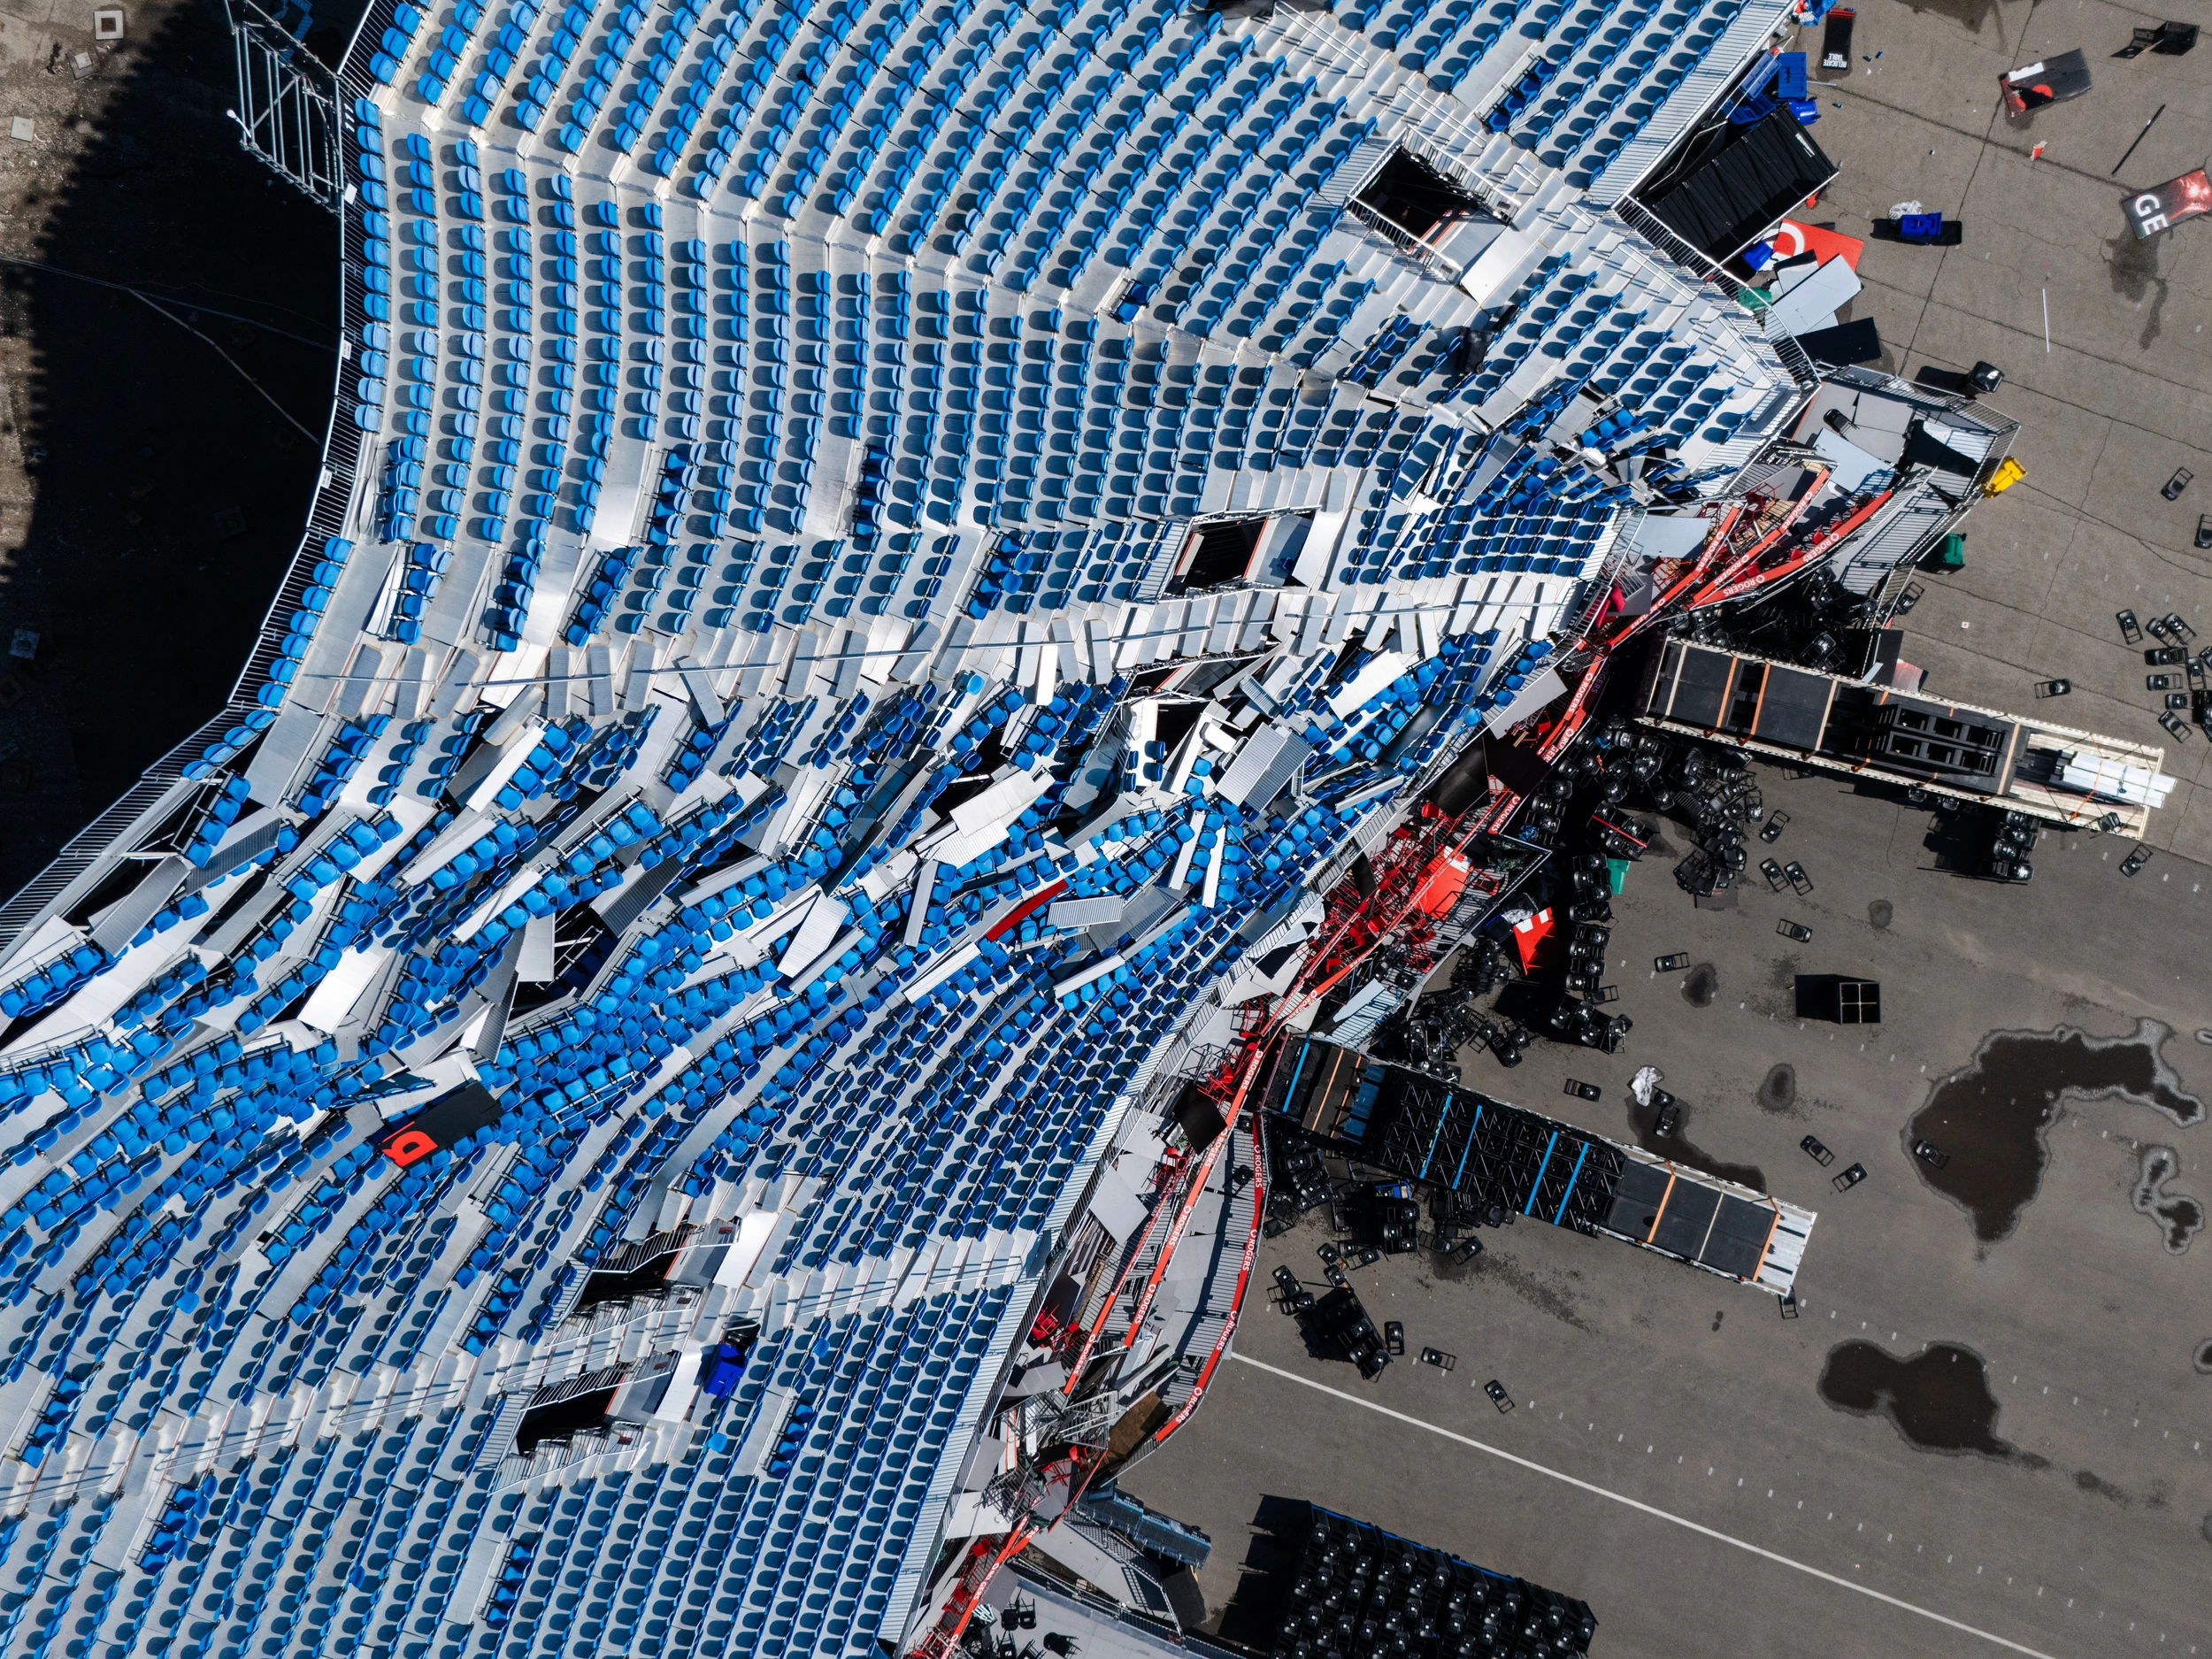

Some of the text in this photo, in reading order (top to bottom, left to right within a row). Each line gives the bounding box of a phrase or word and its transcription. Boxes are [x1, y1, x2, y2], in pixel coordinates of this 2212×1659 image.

[2135, 194, 2169, 235] GE
[1781, 500, 1810, 531] ROGERS
[1695, 541, 1721, 572] ROGERS
[1803, 541, 1834, 563] ROGERS
[1714, 561, 1745, 587] ROGERS
[1723, 577, 1756, 596] ROGERS
[1568, 681, 1588, 713] ROGERS
[1241, 1056, 1259, 1090] ROGERS
[1204, 1135, 1224, 1168] ROGERS
[1169, 1213, 1187, 1247] ROGERS
[1242, 1239, 1257, 1271] ROGERS
[1134, 1293, 1154, 1325] ROGERS
[1073, 1340, 1091, 1375] ROGERS
[1176, 1395, 1198, 1424] ROGERS
[973, 1569, 995, 1600] ROGERS
